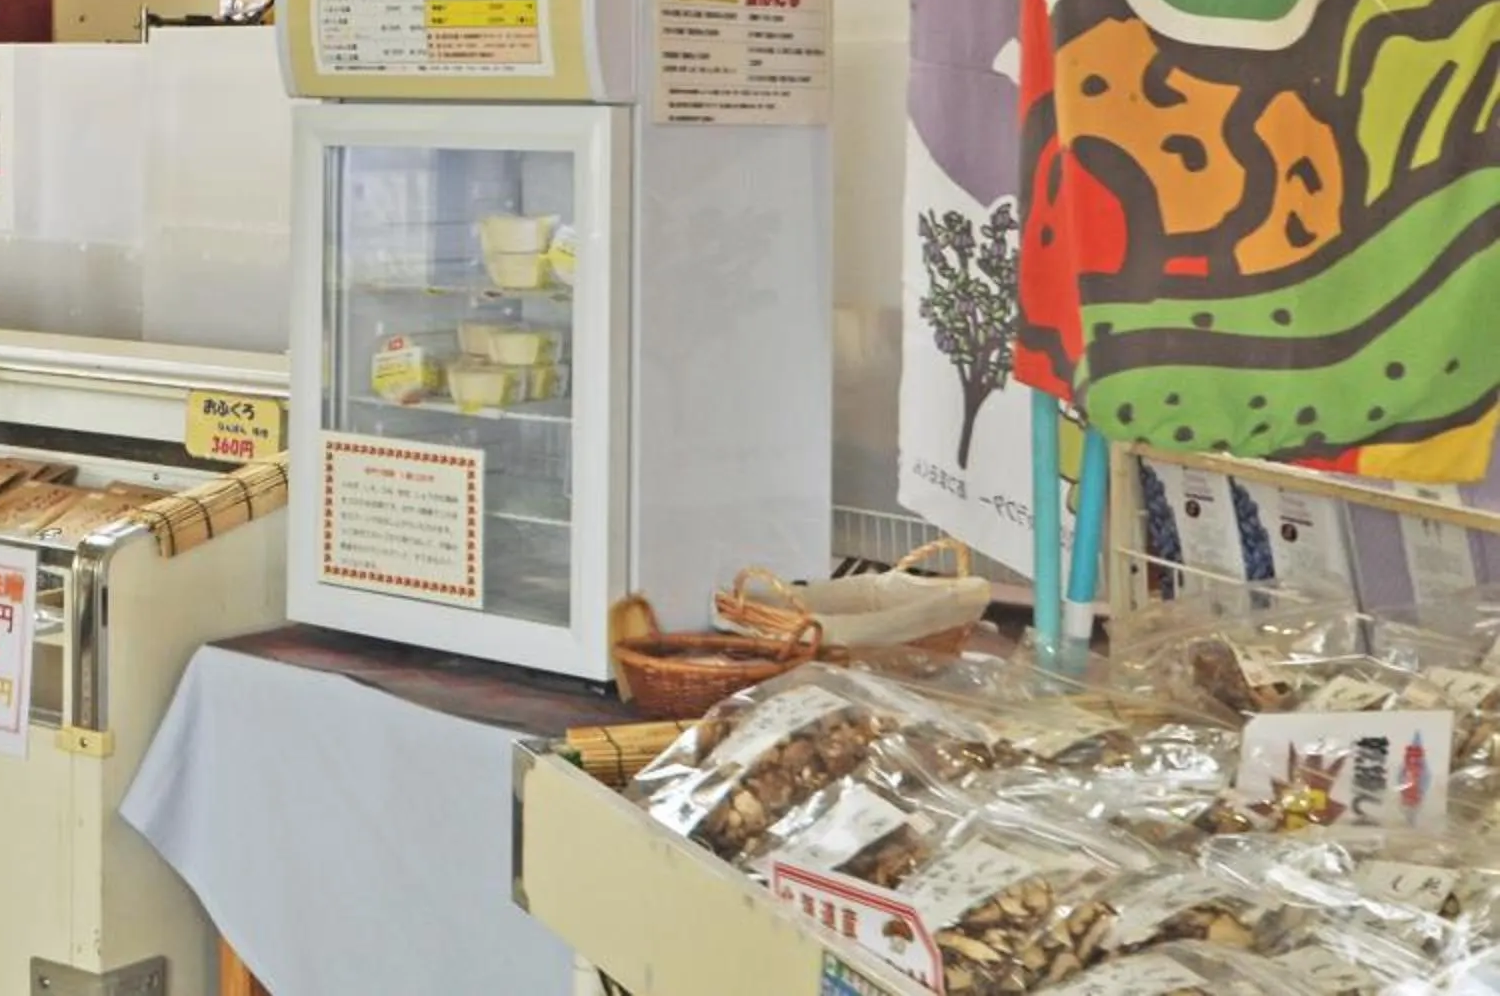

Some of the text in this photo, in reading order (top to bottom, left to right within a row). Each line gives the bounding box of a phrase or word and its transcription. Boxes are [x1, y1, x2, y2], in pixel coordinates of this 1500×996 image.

[203, 399, 256, 420] おふくろ
[211, 435, 255, 459] 360円
